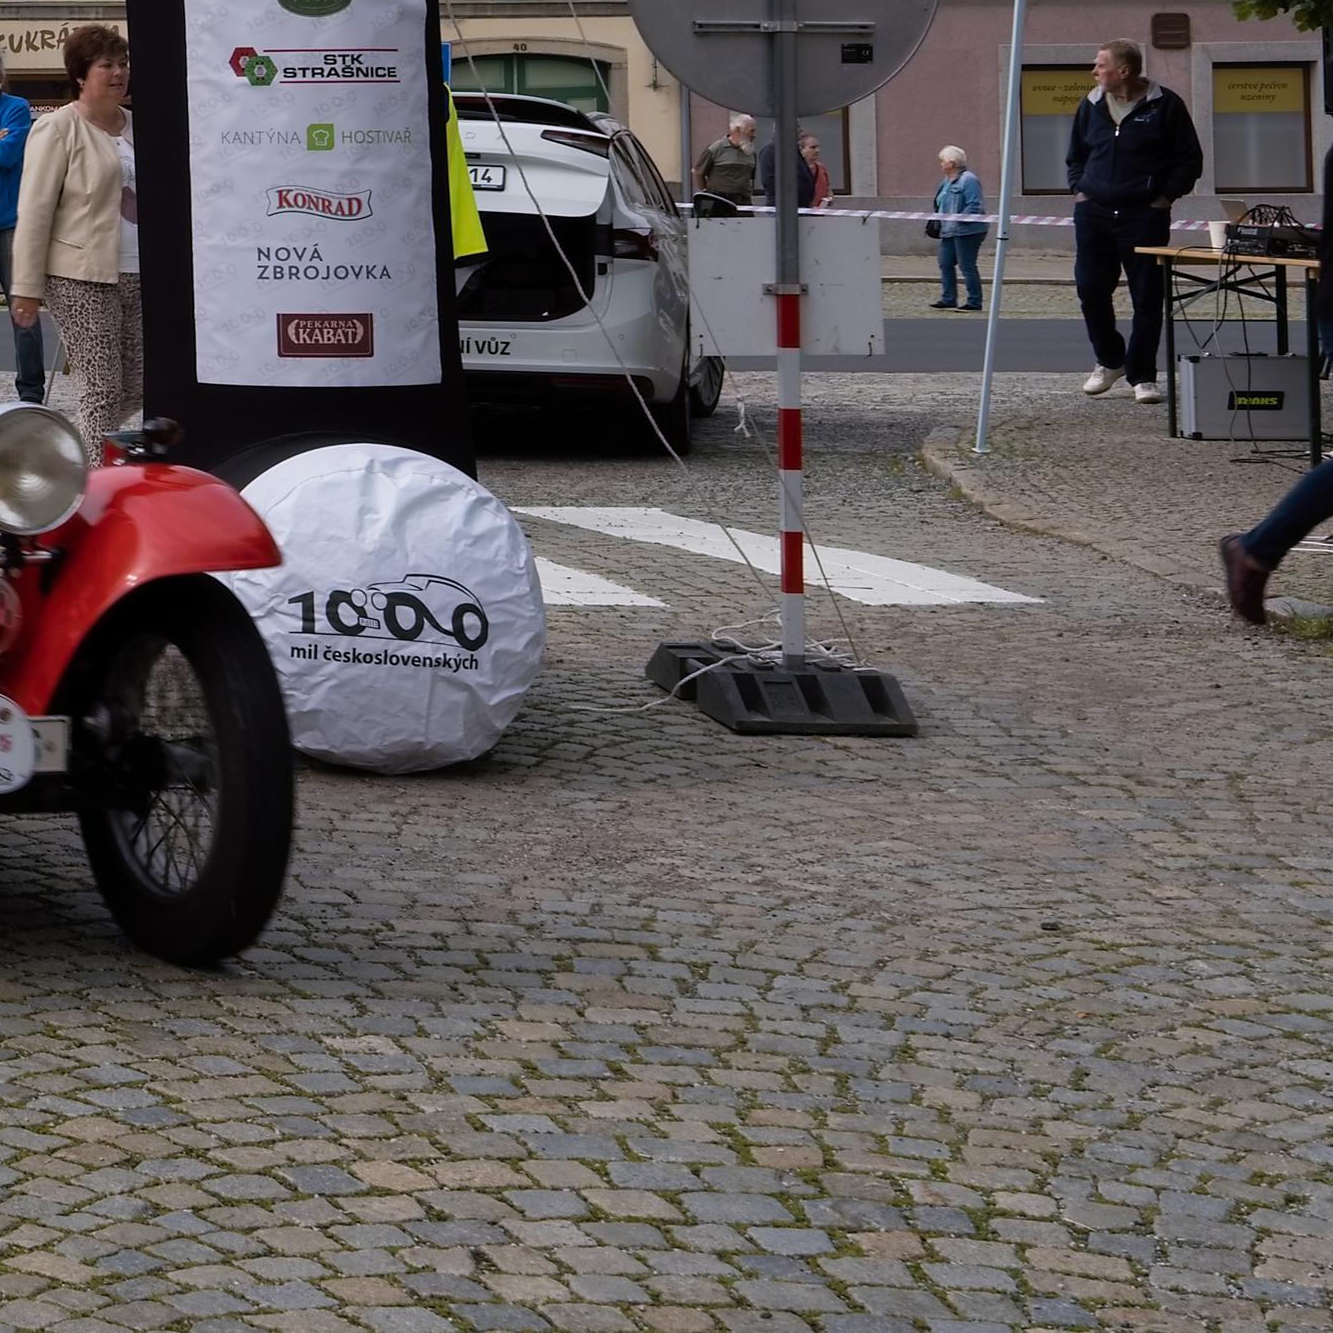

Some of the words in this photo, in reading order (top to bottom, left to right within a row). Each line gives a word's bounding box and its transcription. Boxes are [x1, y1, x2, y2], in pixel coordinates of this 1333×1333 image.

[513, 43, 528, 52] 40
[323, 53, 364, 66] STK
[282, 63, 398, 79] STRAŠNICE
[221, 126, 301, 145] KANTÝNA
[341, 126, 412, 145] HOSTIVAŘ
[276, 188, 363, 218] KONRAD
[256, 242, 324, 263] NOVÁ
[256, 264, 392, 281] ZBROJOVKA
[474, 336, 511, 356] VŮZ
[290, 643, 318, 660] mil
[323, 645, 479, 673] československých
